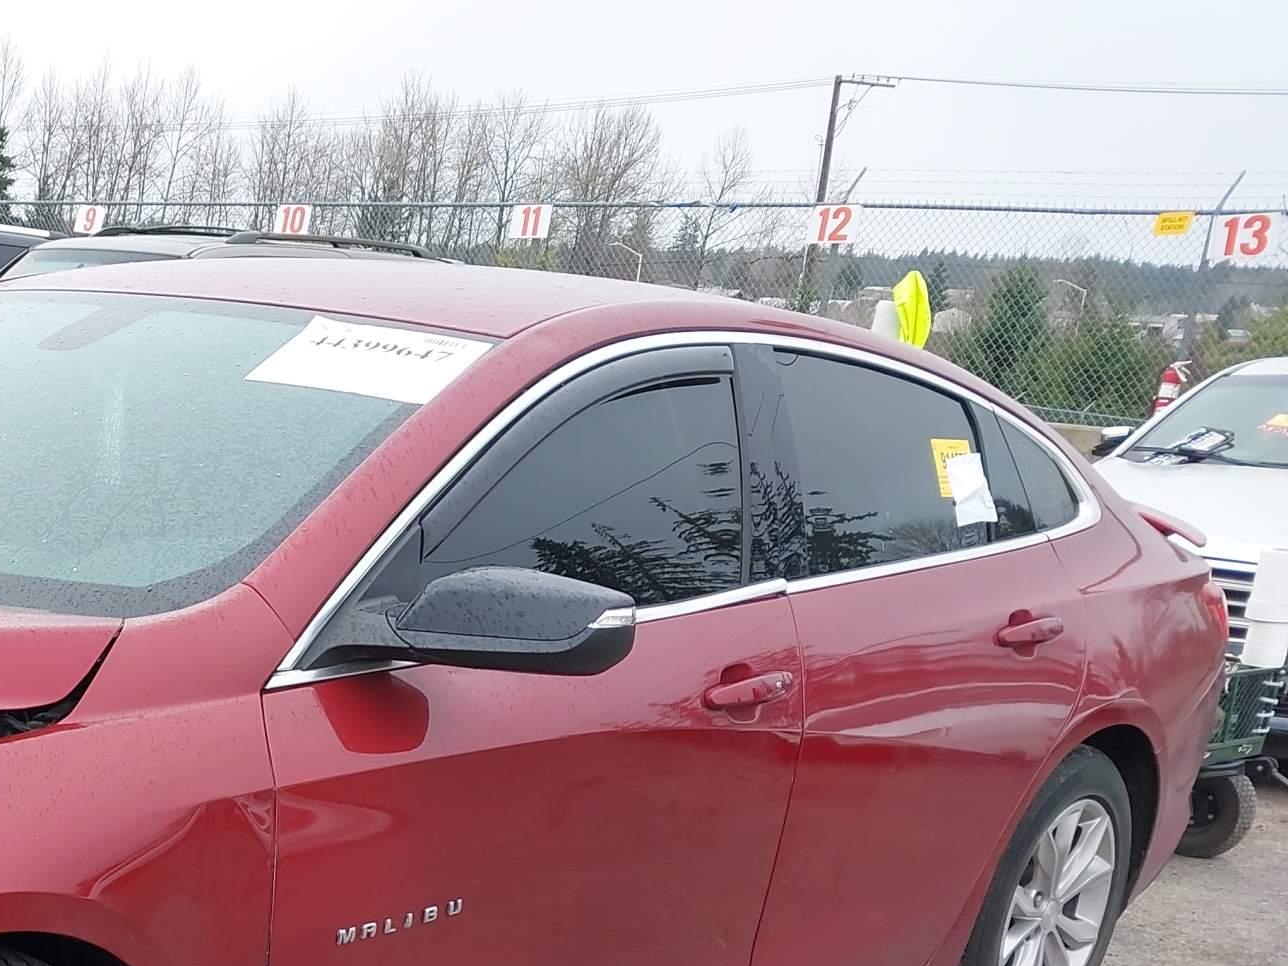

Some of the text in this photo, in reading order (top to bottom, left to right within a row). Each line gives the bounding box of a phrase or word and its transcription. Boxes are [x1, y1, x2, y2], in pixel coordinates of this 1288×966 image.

[83, 207, 96, 232] 9
[281, 206, 306, 233] 10
[521, 206, 543, 237] 11
[817, 207, 852, 241] 12
[1224, 214, 1272, 256] 13
[309, 335, 454, 362] 44399647
[336, 897, 463, 946] MALIBU
